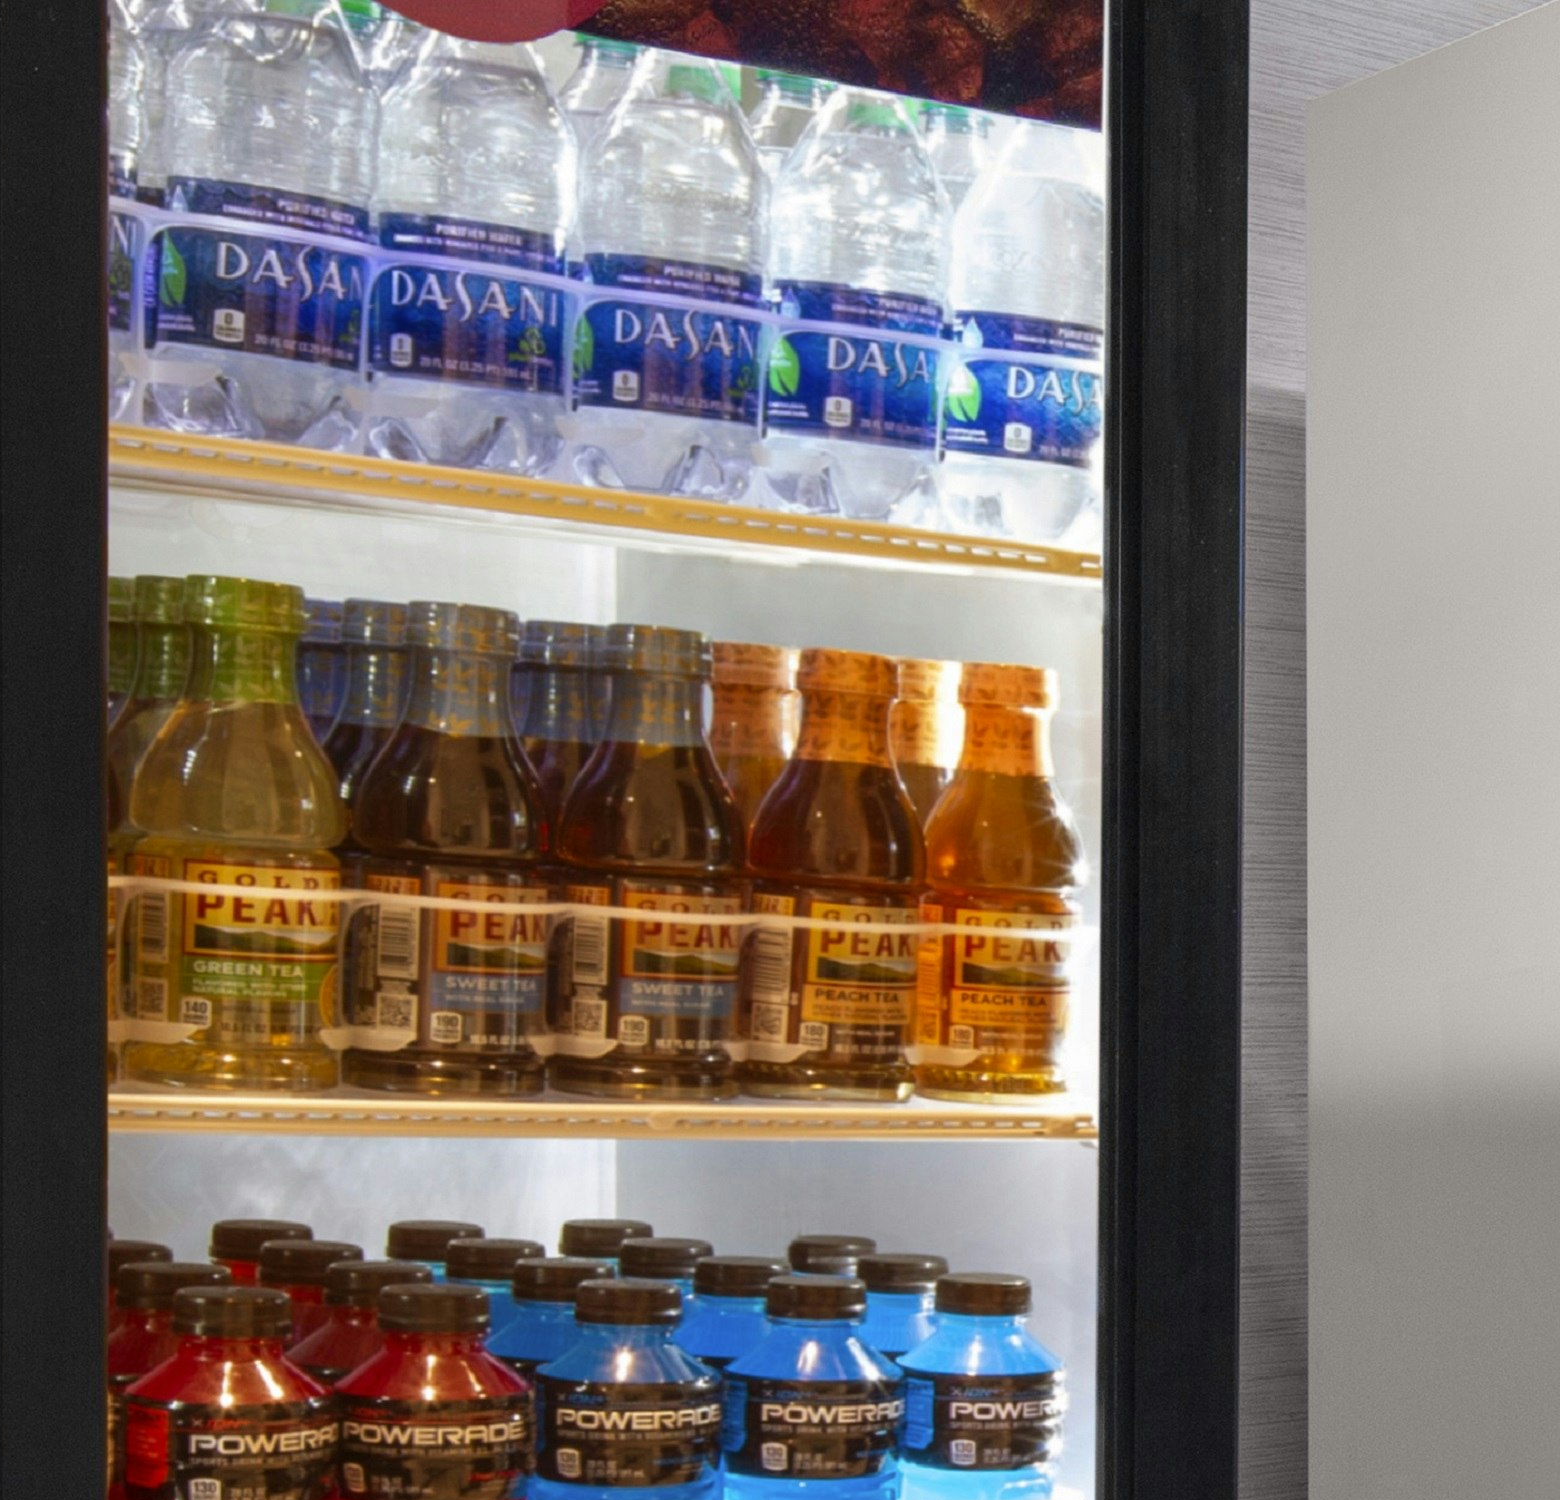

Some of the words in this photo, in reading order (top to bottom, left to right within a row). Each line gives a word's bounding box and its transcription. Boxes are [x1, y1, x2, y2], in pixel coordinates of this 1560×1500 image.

[391, 270, 558, 329] DASANI
[196, 890, 318, 926] PEAK
[638, 921, 738, 950] PEAK
[820, 924, 914, 958] PEAK
[964, 932, 1064, 962] PEAK
[193, 959, 264, 979] GREEN
[268, 963, 304, 979] TEA
[445, 976, 509, 992] SWEET
[513, 979, 538, 992] TEA
[631, 981, 696, 998] SWEET
[699, 983, 725, 998] TEA
[815, 987, 870, 1004] PEACH
[874, 991, 900, 1005] TEA
[961, 992, 1015, 1008] PEACH
[1019, 995, 1048, 1008] TEA
[556, 1403, 723, 1432] POWERADE
[343, 1420, 525, 1446] POWERADE
